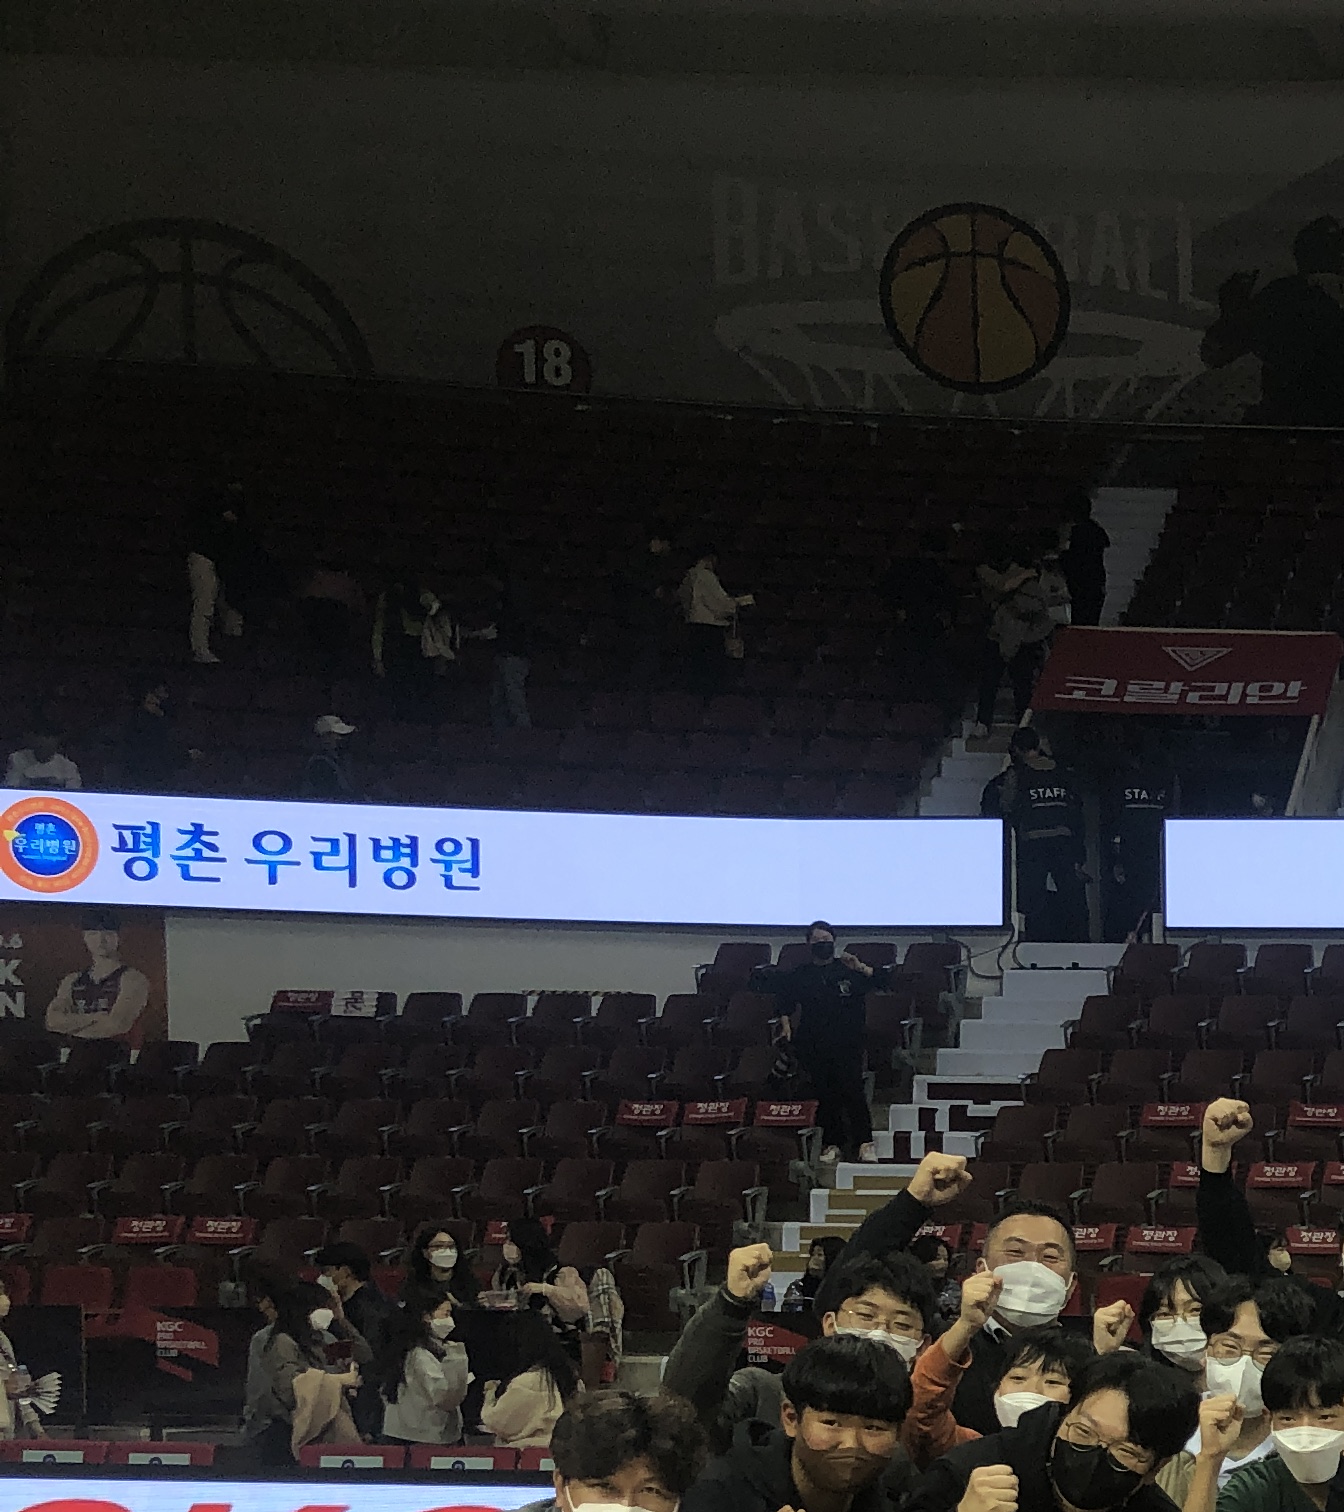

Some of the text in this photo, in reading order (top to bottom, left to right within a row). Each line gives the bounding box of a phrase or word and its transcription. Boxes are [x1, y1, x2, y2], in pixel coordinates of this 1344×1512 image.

[513, 340, 574, 387] 18
[1055, 676, 1308, 704] 코랄리안
[111, 820, 481, 892] 평촌 우리병원
[747, 1326, 775, 1338] KGC
